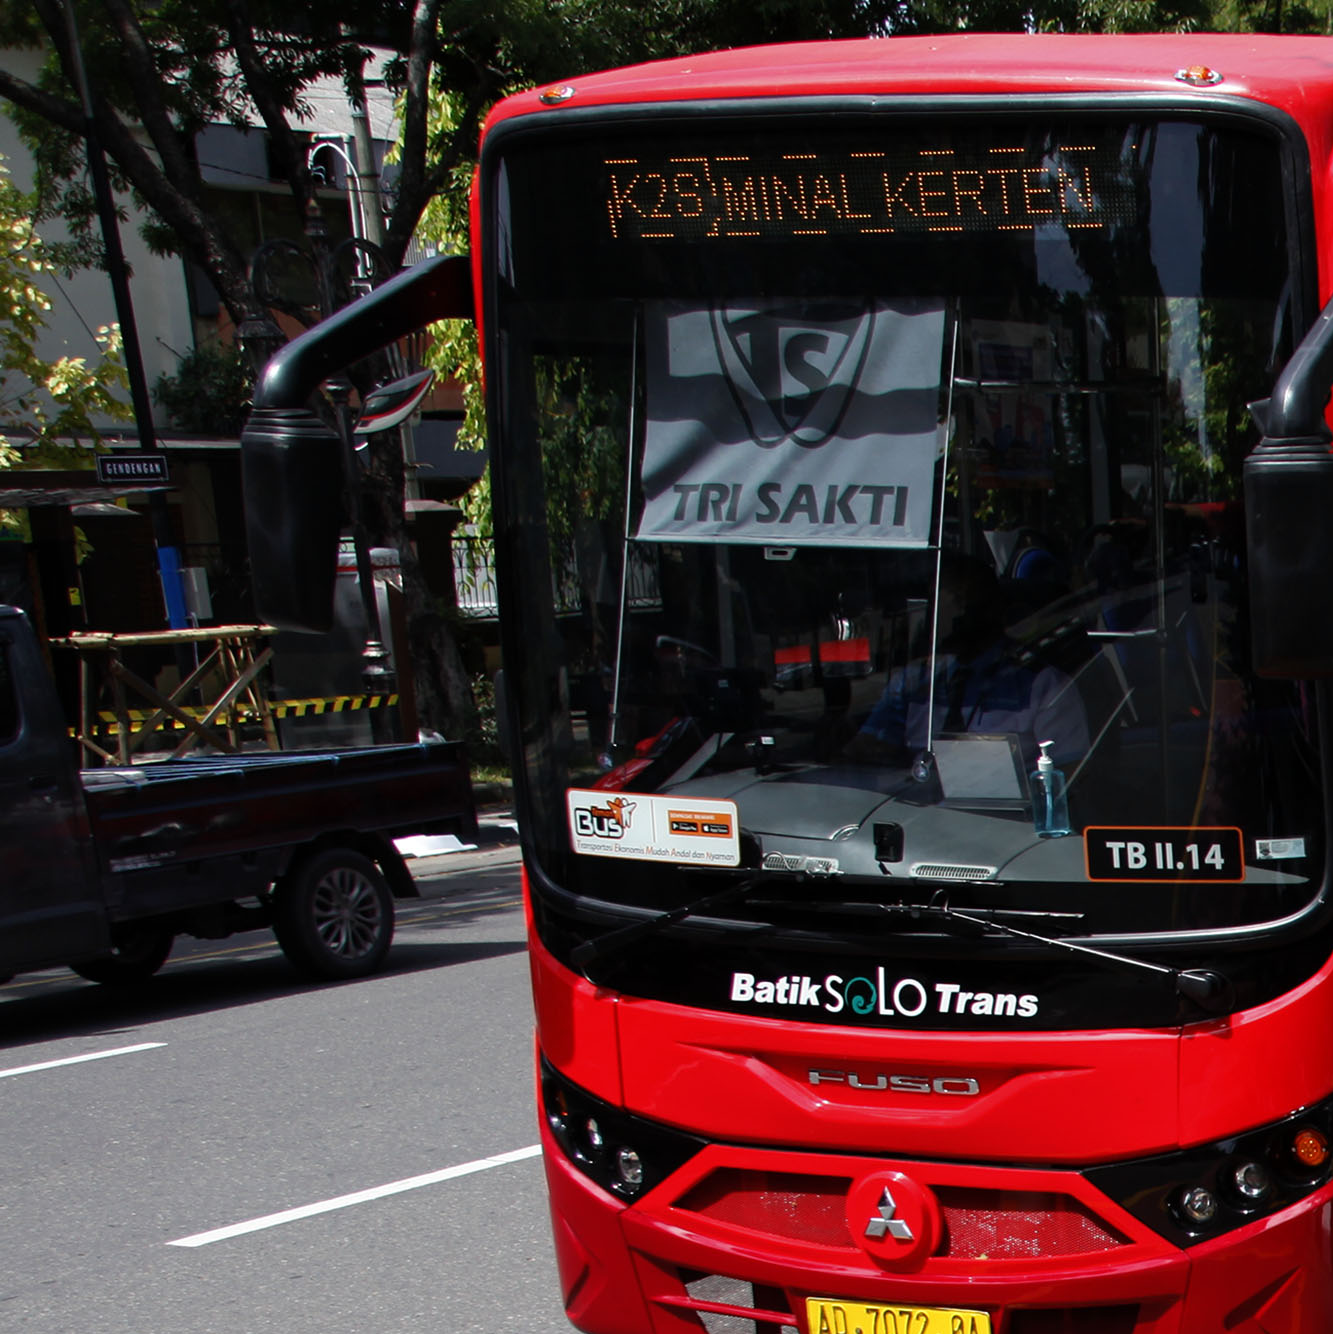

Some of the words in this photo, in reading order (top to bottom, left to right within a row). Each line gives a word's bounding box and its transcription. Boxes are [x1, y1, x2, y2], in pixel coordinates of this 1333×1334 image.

[882, 165, 1094, 218] KERTEN
[673, 482, 743, 522] TRI
[754, 481, 909, 527] SAKTI
[1105, 841, 1148, 870] TB
[1155, 842, 1225, 870] II.14
[731, 971, 823, 1006] Batik
[934, 982, 1039, 1017] Trans
[808, 1068, 980, 1096] FUSO
